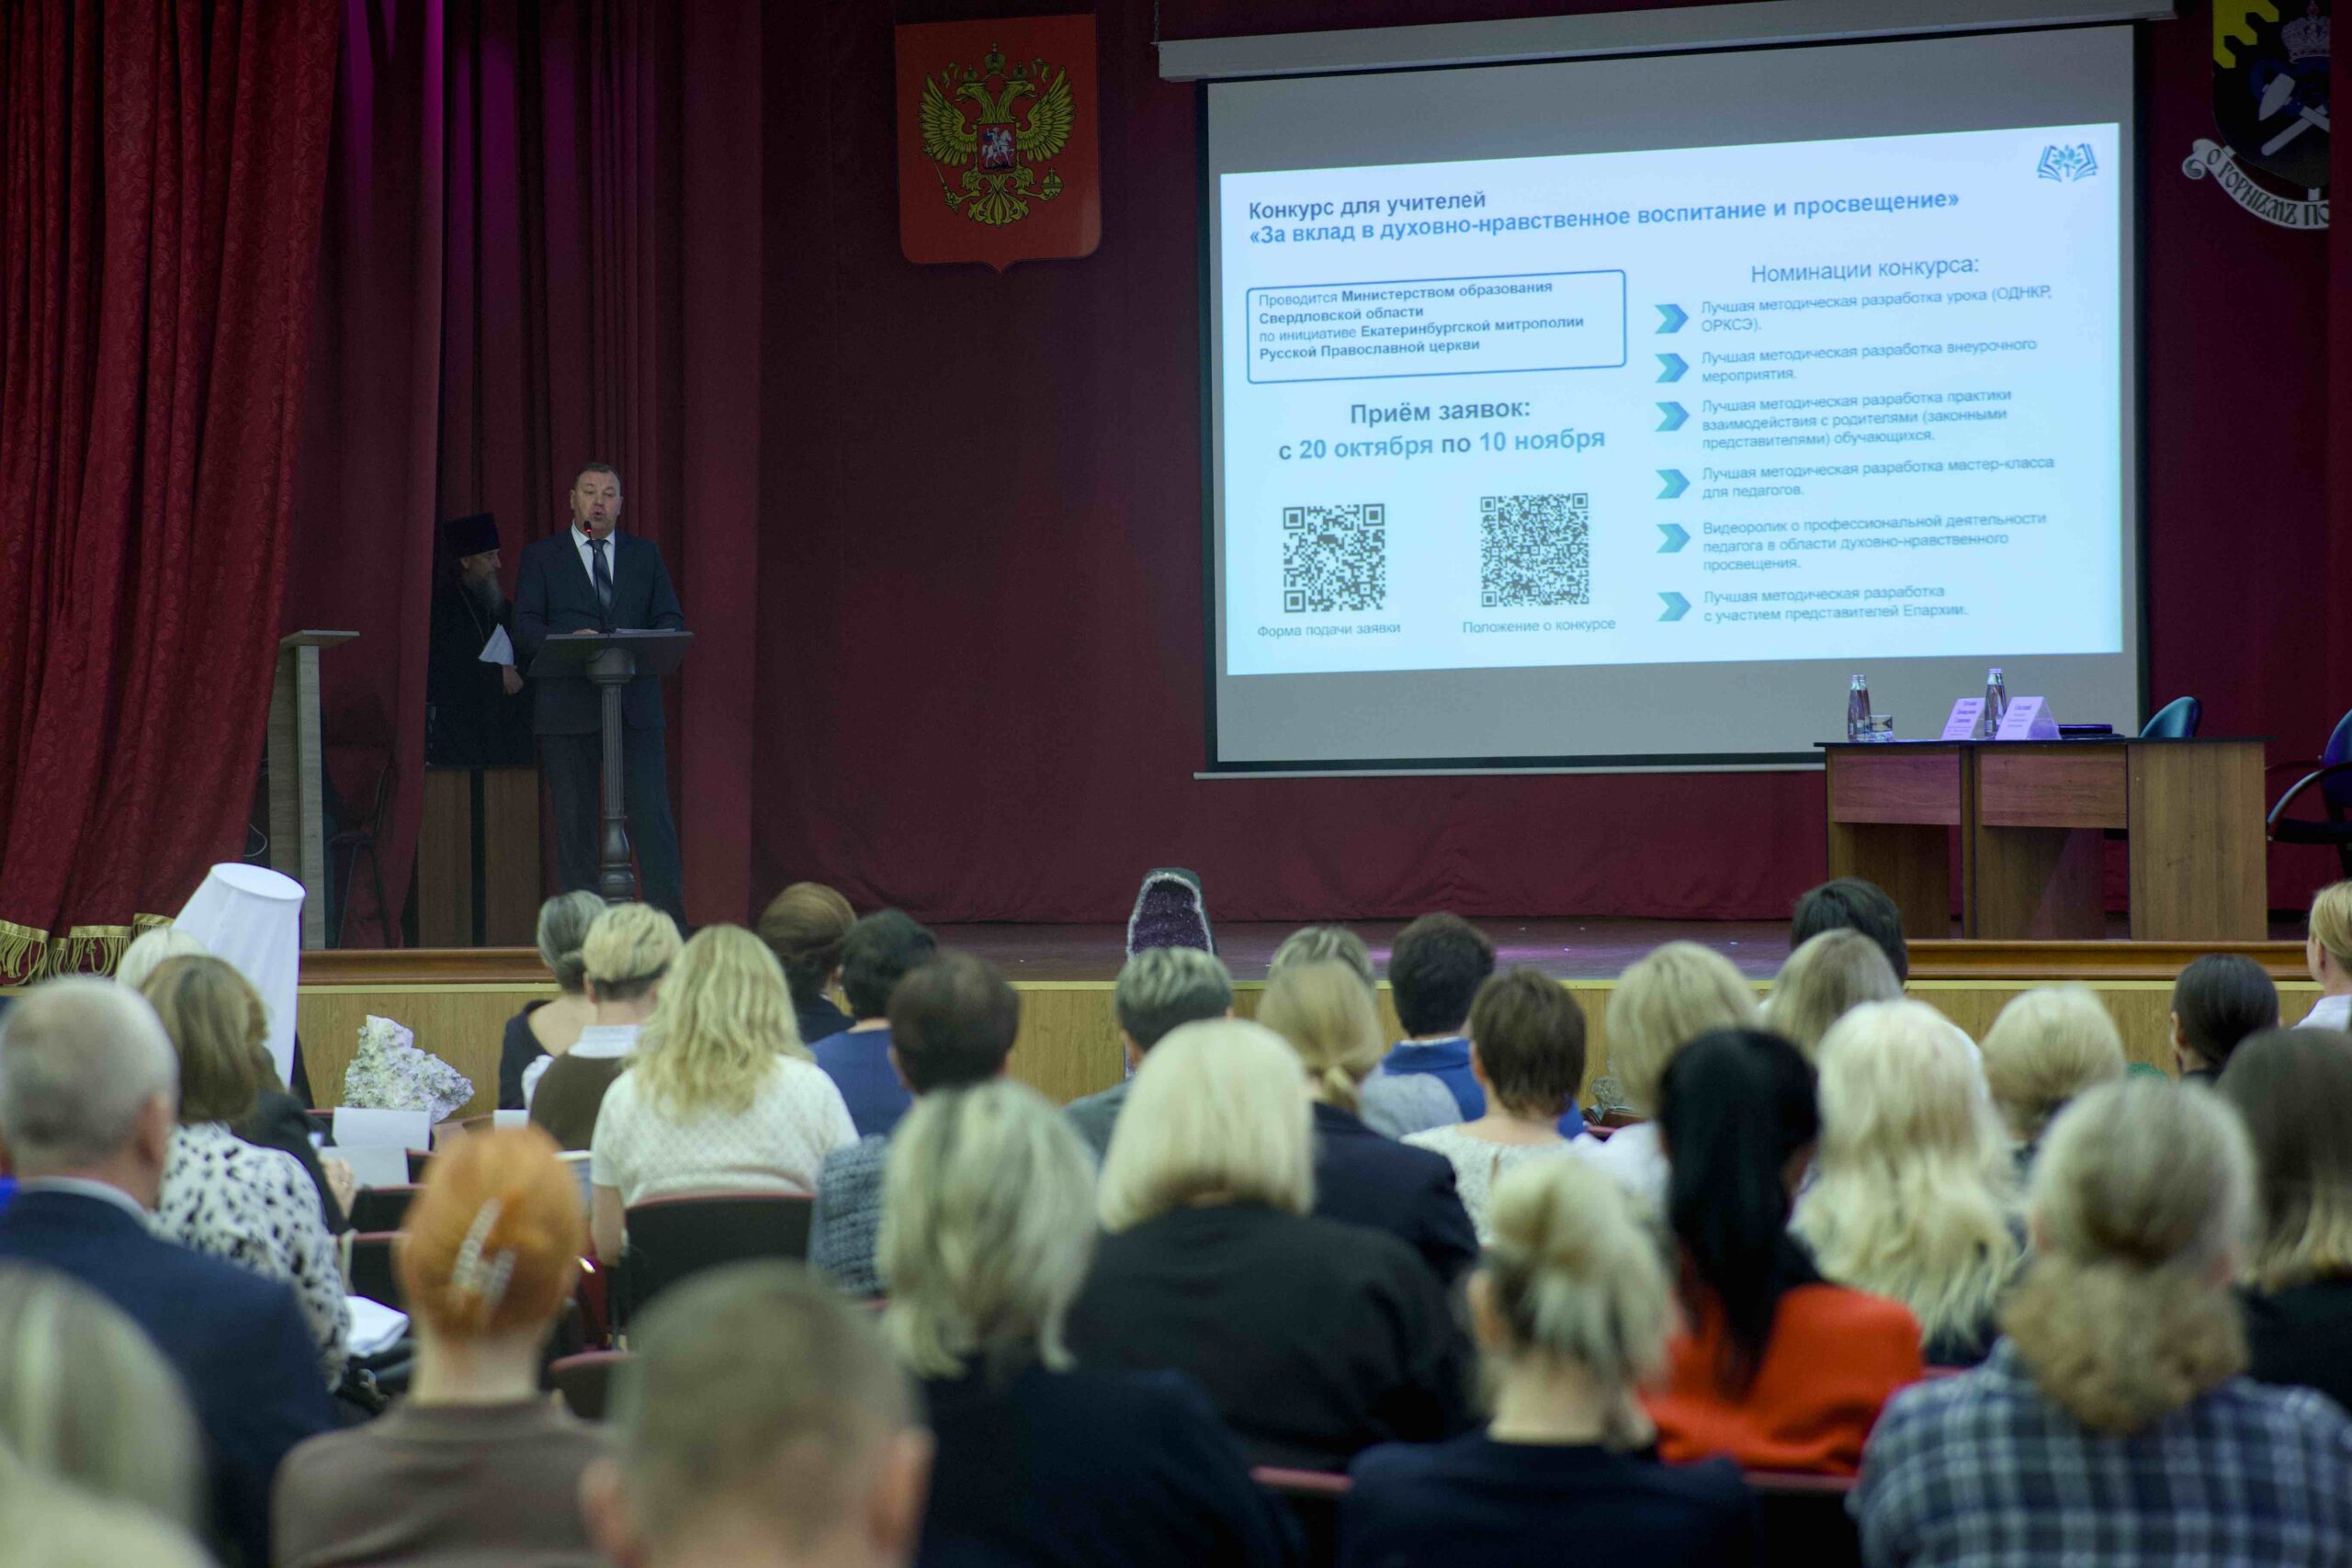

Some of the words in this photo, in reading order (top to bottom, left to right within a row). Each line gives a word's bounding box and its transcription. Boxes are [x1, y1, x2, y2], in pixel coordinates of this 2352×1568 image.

[2207, 149, 2221, 164] О
[1250, 201, 1334, 220] Конкурс
[1340, 199, 1380, 217] для
[1386, 190, 1485, 215] учителей
[1250, 225, 1285, 243] «За
[1293, 225, 1355, 242] вклад
[1362, 224, 1374, 238] в
[1380, 210, 1630, 239] духовно-нравственное
[1637, 203, 1766, 223] воспитание
[1773, 202, 1786, 216] и
[1793, 193, 1959, 218] просвещение»
[1751, 264, 1871, 283] Номинации
[1878, 258, 1979, 279] конкурса:
[1259, 293, 1337, 307] Проводится
[1341, 288, 1454, 301] Министерством
[1458, 282, 1552, 298] образования
[1701, 300, 1755, 315] Лучшая
[1758, 297, 1857, 311] методическая
[1861, 290, 1942, 308] разработка
[1946, 290, 1987, 304] урока
[1259, 308, 1361, 324] Свердловской
[1365, 306, 1423, 319] области
[1259, 332, 1275, 342] по
[1278, 328, 1356, 341] инициативе
[1361, 319, 1490, 338] Екатеринбургской
[1495, 317, 1583, 332] митрополии
[1260, 345, 1317, 361] Русской
[1320, 341, 1424, 358] Православной
[1429, 340, 1479, 353] церкви
[1702, 351, 1756, 366] Лучшая
[1758, 347, 1859, 362] методическая
[1860, 342, 1942, 359] разработка
[1946, 339, 2037, 355] внеурочного
[1702, 400, 1756, 413] Лучшая
[1758, 396, 1858, 411] методическая
[1861, 391, 1943, 408] разработка
[1947, 390, 2011, 404] практики
[1351, 401, 1430, 427] Приём
[1438, 401, 1530, 420] заявок:
[1702, 416, 1816, 431] взаимодействия
[1819, 416, 1828, 426] с
[1832, 412, 1917, 428] родителями
[1921, 409, 2007, 424] (законными
[1278, 445, 1292, 460] с
[1299, 439, 1326, 458] 20
[1333, 434, 1432, 459] октября
[1442, 436, 1471, 453] по
[1479, 431, 1506, 451] 10
[1514, 428, 1605, 453] ноября
[1702, 434, 1830, 449] представителями)
[1702, 467, 1756, 482] Лучшая
[1759, 464, 1859, 478] методическая
[1861, 459, 1944, 476] разработка
[1947, 457, 2054, 471] мастер-класса
[1702, 488, 1728, 500] для
[1702, 522, 1787, 536] Видеоролик
[1790, 521, 1799, 531] о
[1804, 514, 1942, 533] профессиональной
[1944, 513, 2046, 528] деятельности
[1703, 541, 1763, 555] педагога
[1767, 540, 1775, 551] в
[1779, 537, 1838, 550] области
[1839, 534, 2008, 551] духовно-нравственного
[1703, 591, 1758, 605] Лучшая
[1760, 589, 1860, 603] методическая
[1863, 584, 1945, 602] разработка
[1462, 621, 1540, 633] Положение
[1542, 621, 1552, 631] о
[1555, 619, 1616, 632] конкурсе
[1703, 612, 1713, 622] с
[1714, 610, 1781, 625] участием
[1784, 604, 1899, 622] представителей
[1257, 626, 1302, 639] Форма
[1306, 625, 1352, 637] подачи
[1356, 624, 1400, 634] заявки
